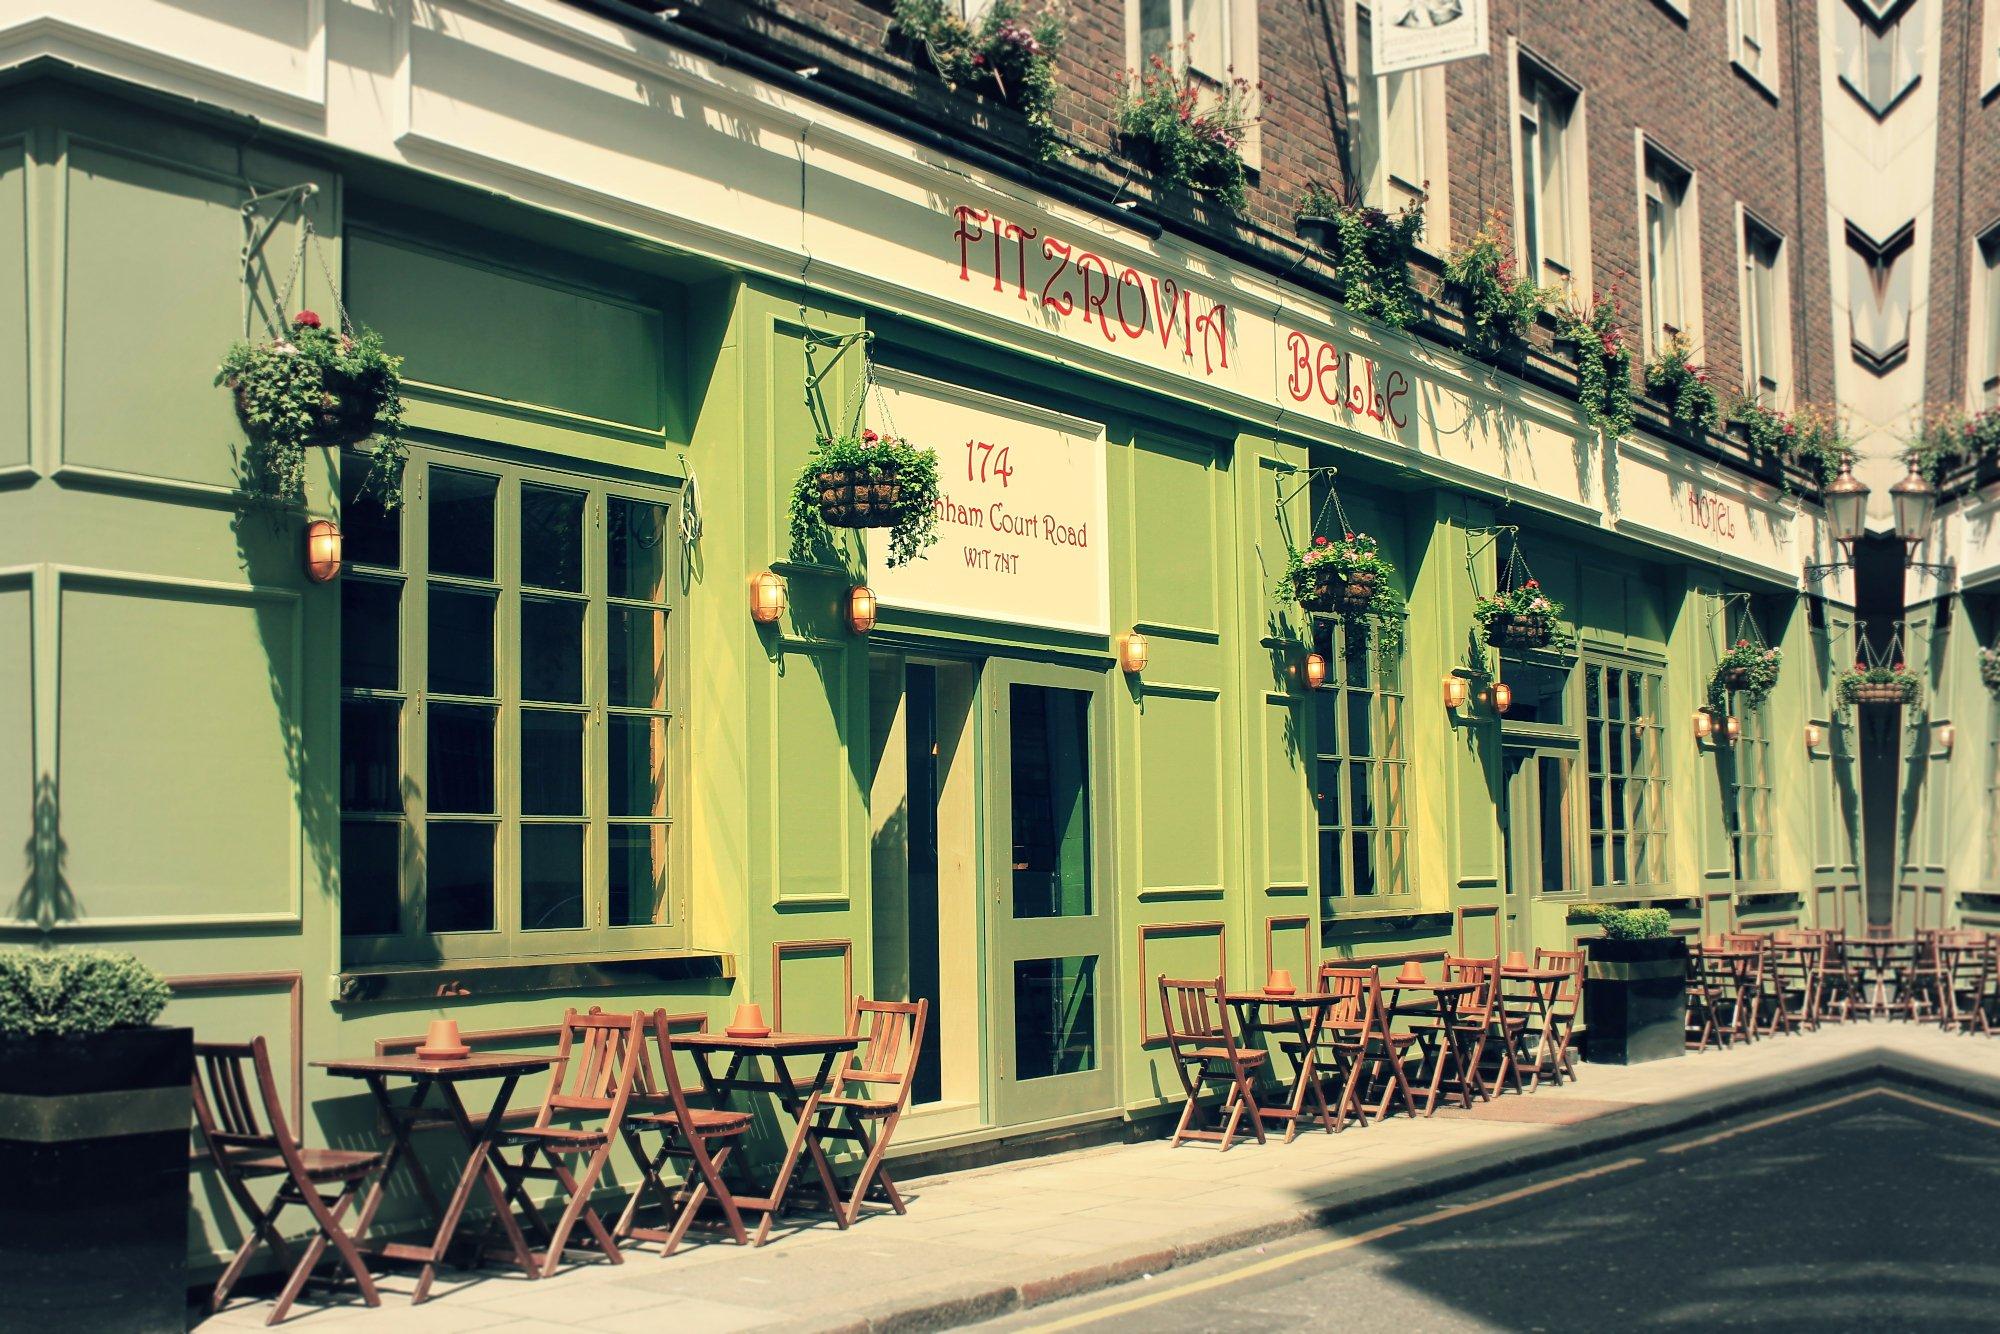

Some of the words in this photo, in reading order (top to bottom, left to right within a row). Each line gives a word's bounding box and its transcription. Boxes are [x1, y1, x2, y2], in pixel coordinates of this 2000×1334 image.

[953, 205, 1228, 376] FITZROVIA
[1287, 331, 1409, 429] BELLE
[966, 439, 1014, 487] 174
[989, 502, 1038, 539] Court
[1043, 515, 1088, 548] Road
[1688, 491, 1735, 539] HOTEL
[993, 552, 1020, 575] 7NT
